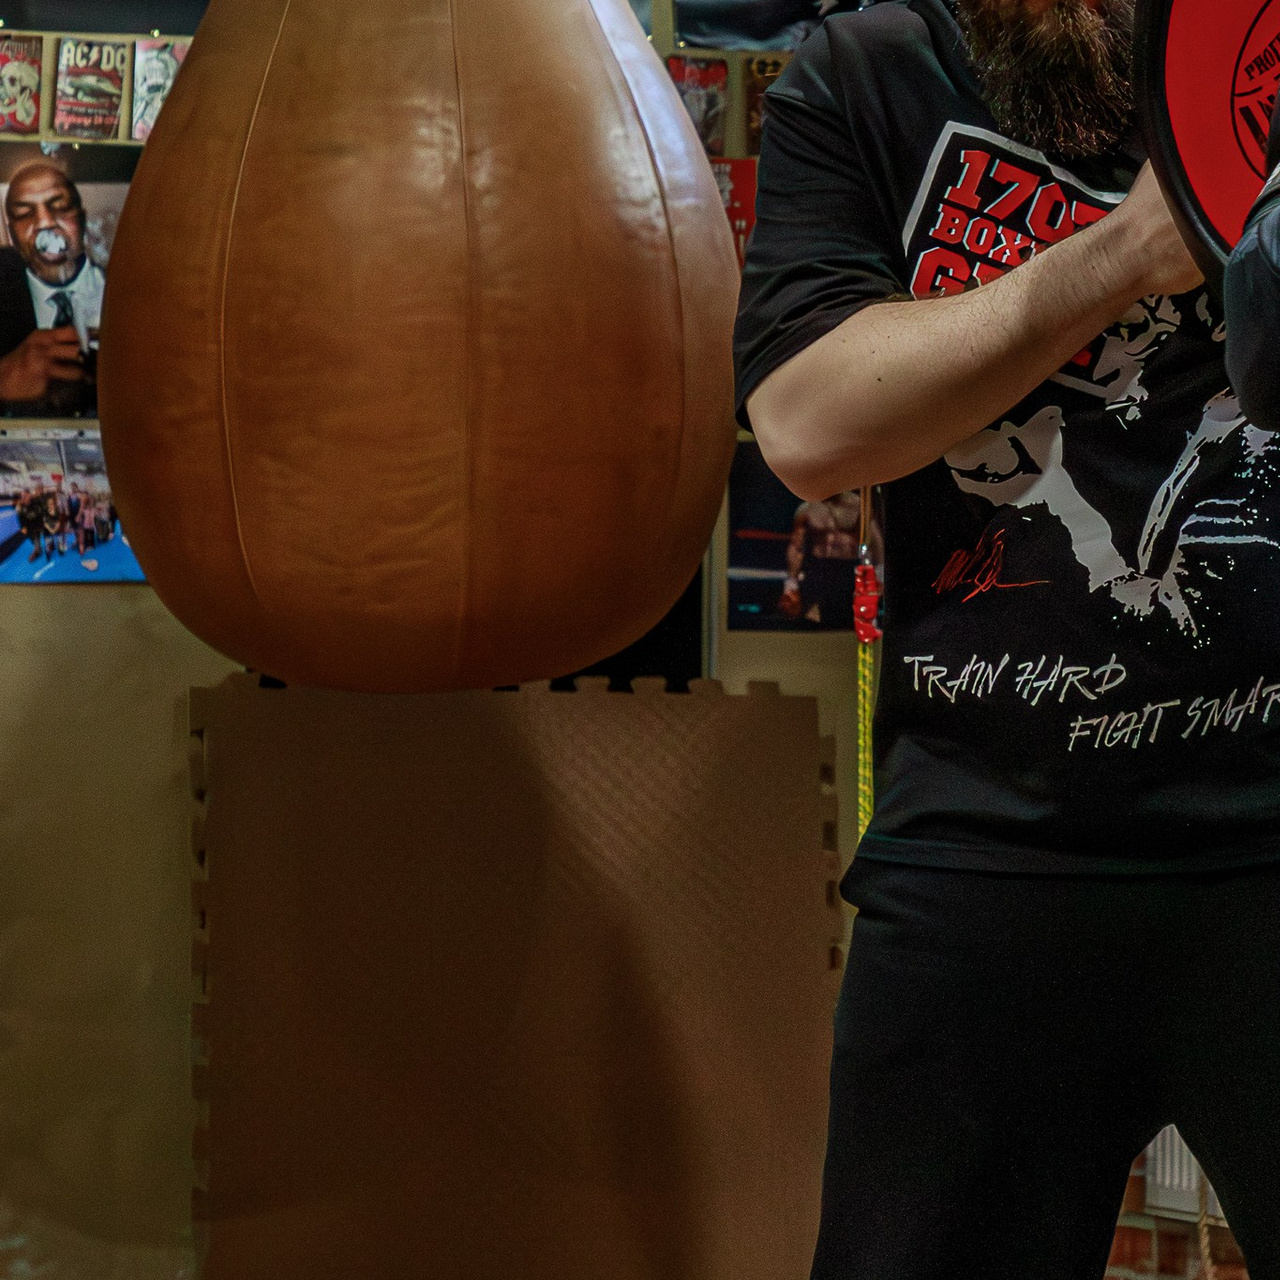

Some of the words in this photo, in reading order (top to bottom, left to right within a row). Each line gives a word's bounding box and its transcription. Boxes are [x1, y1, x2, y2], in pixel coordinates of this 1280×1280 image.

[903, 652, 1010, 704] TRAIN
[1015, 652, 1127, 707] HARD
[1067, 698, 1182, 752] FIGHT
